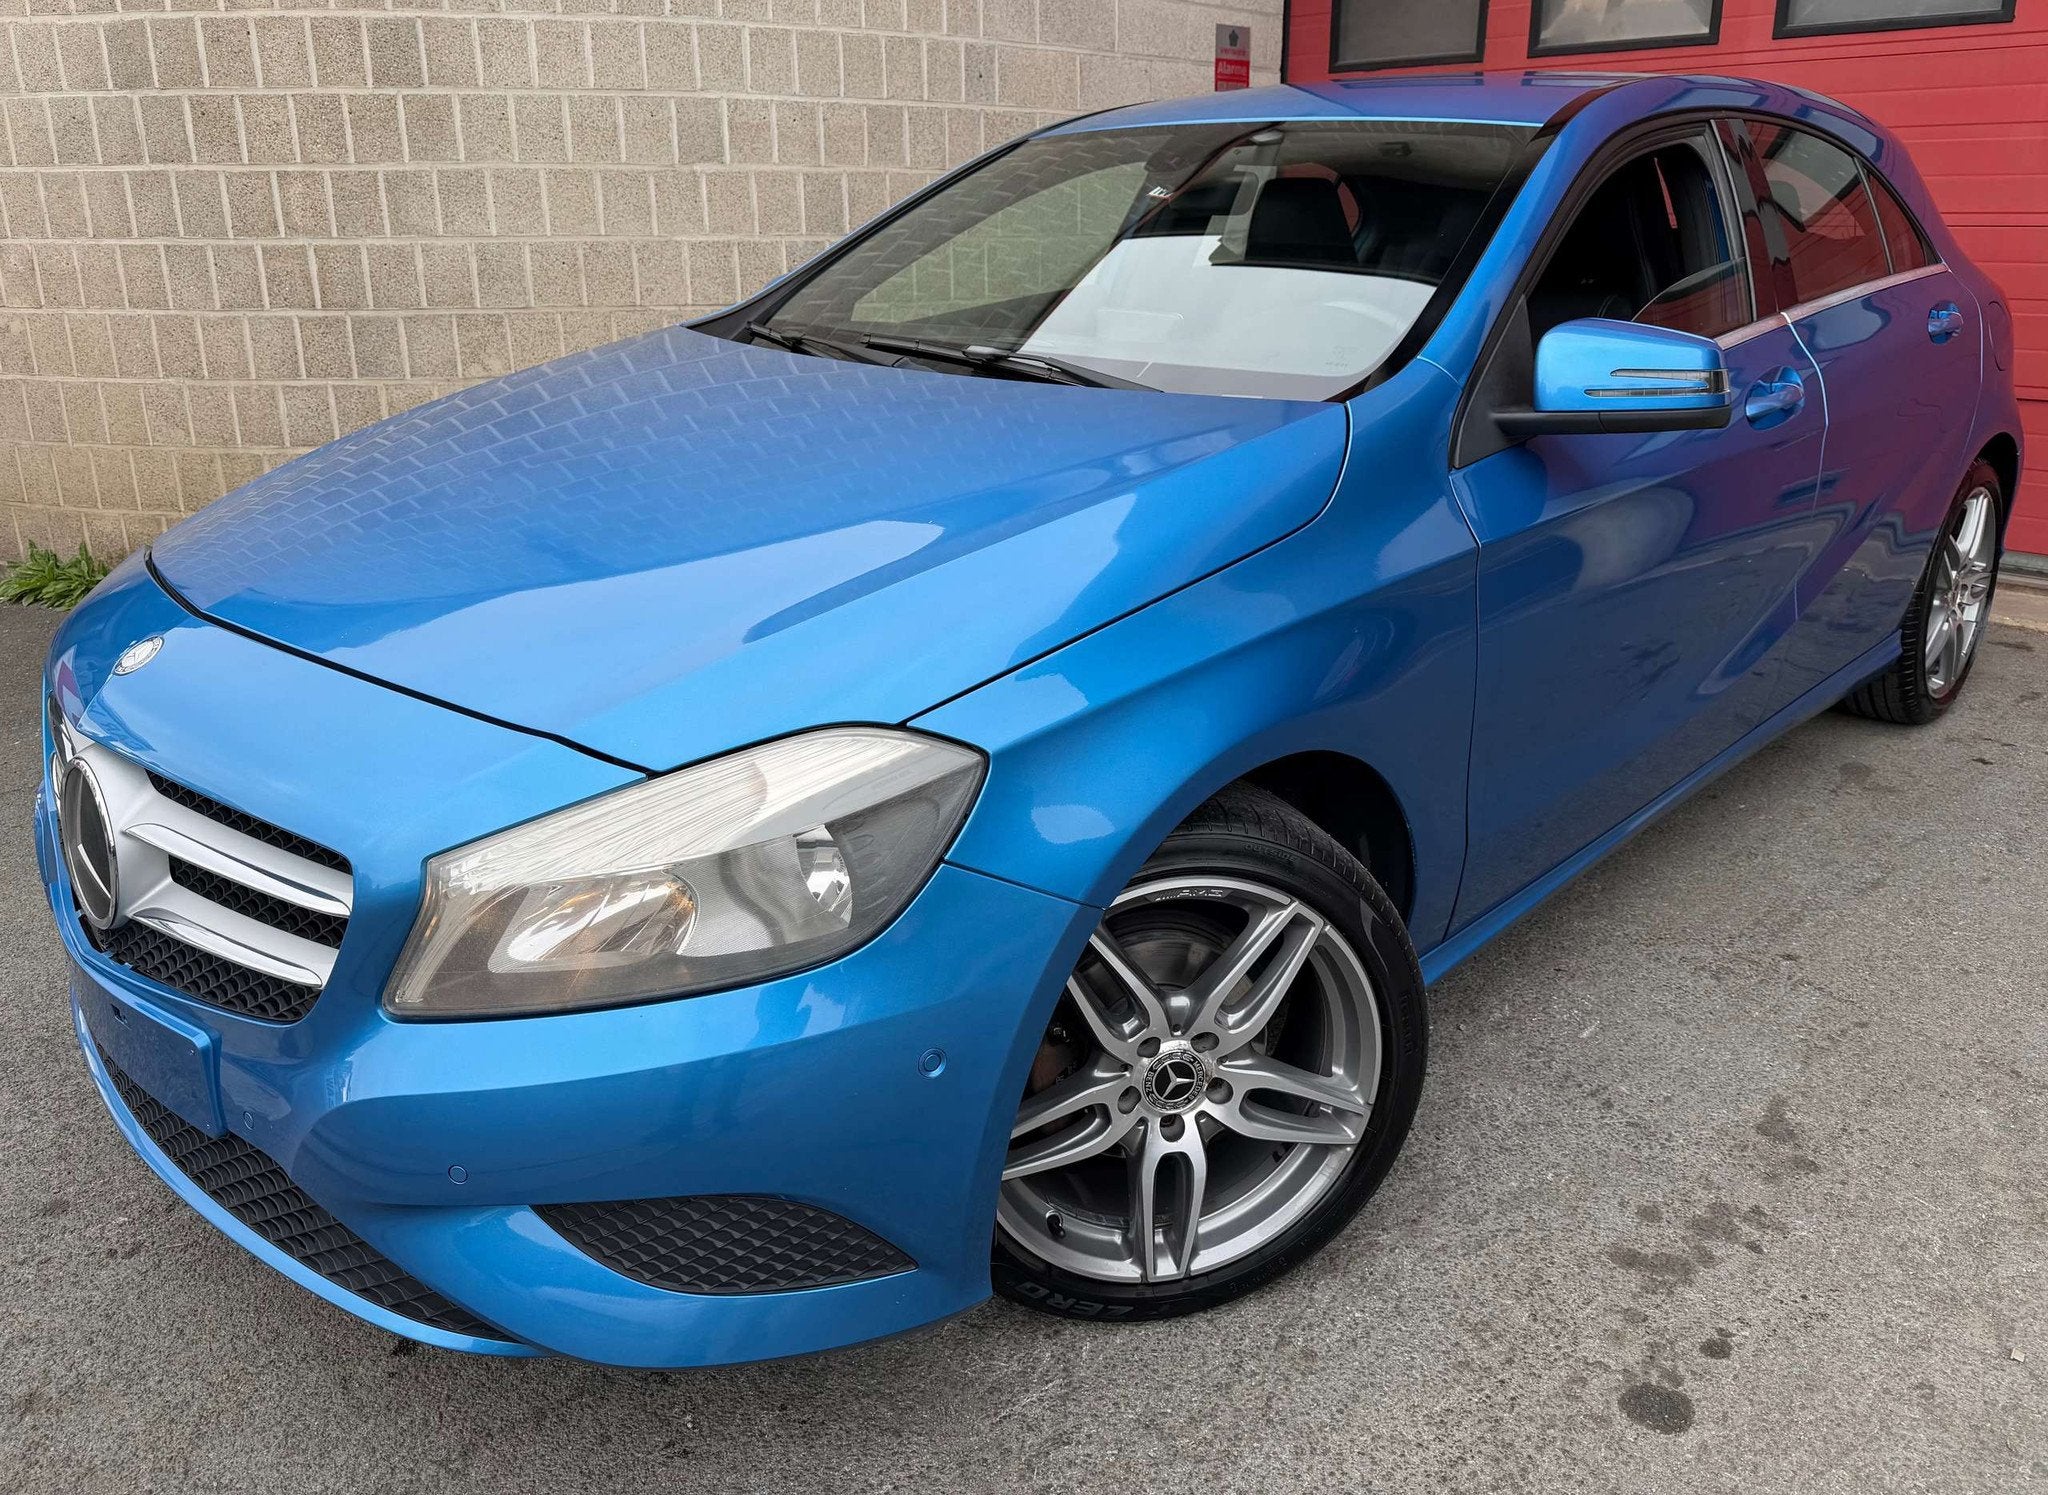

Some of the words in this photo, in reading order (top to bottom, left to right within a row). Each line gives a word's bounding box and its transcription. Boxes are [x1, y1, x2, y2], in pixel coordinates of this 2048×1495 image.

[1145, 1071, 1155, 1093] BENZ
[1188, 1060, 1204, 1101] MERCEDES
[1015, 1281, 1134, 1316] ZERO
